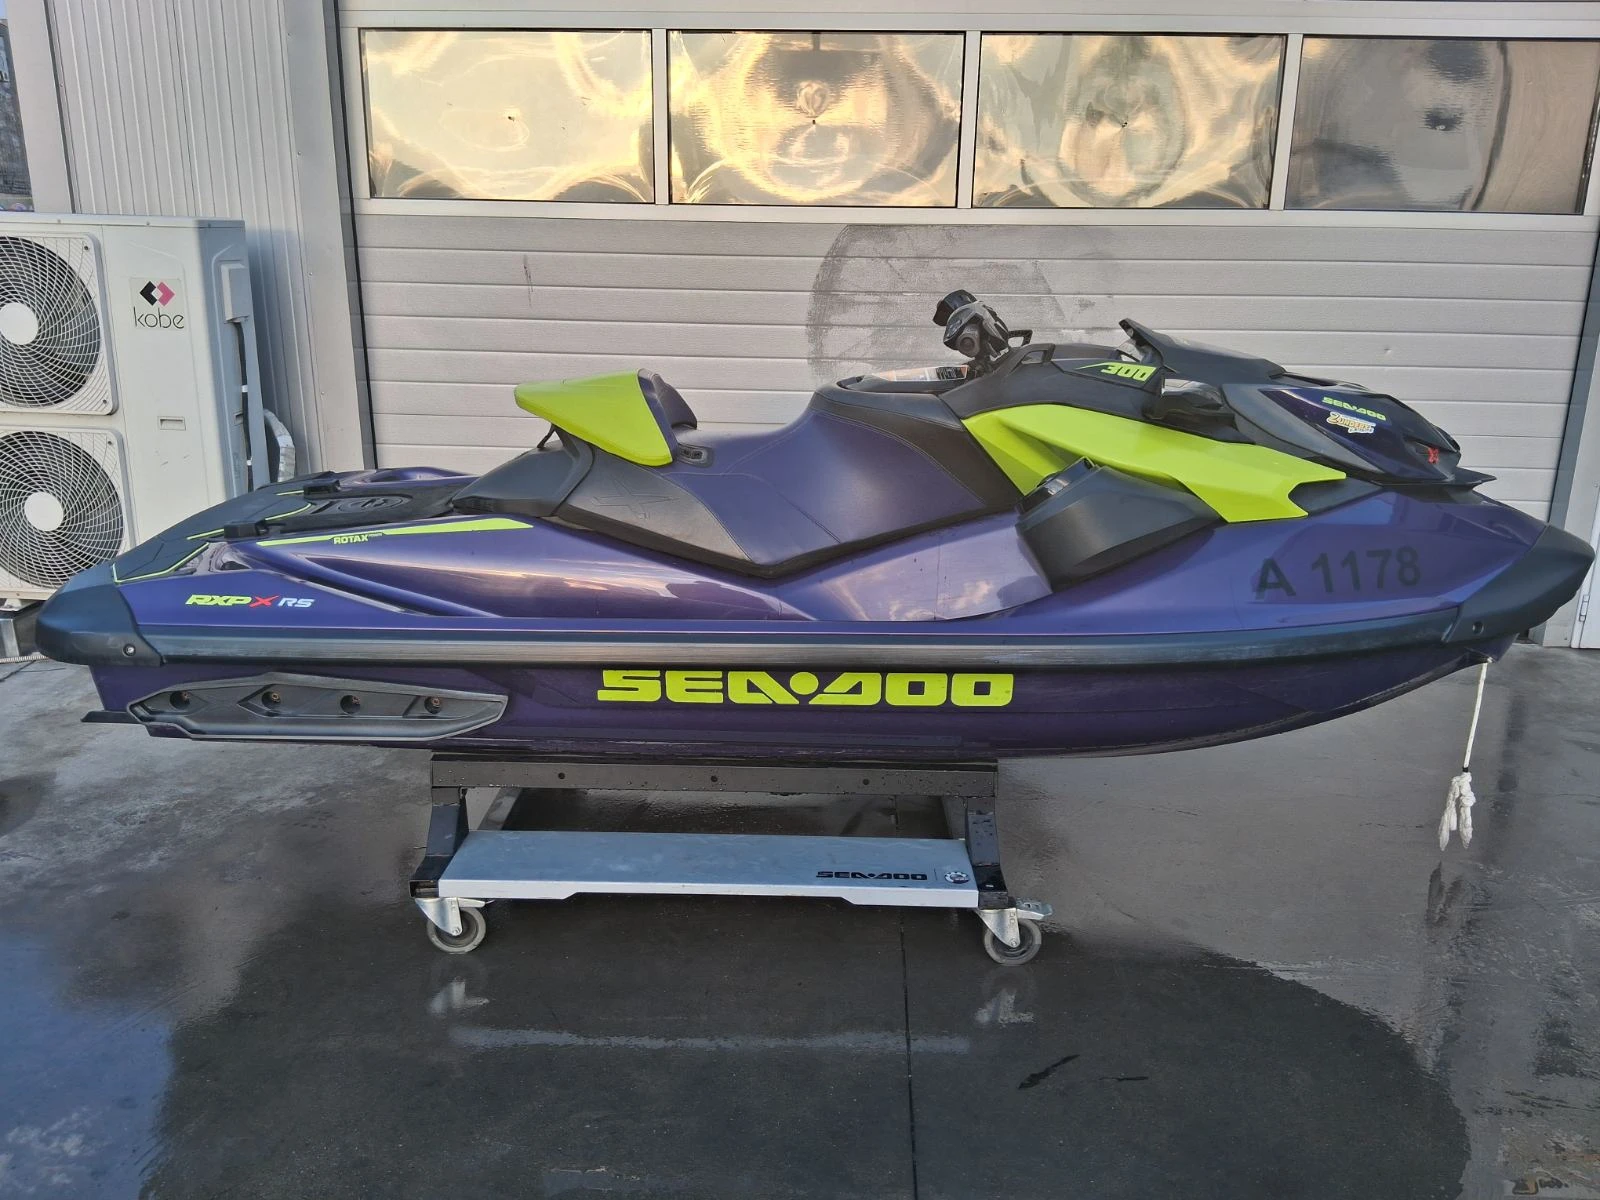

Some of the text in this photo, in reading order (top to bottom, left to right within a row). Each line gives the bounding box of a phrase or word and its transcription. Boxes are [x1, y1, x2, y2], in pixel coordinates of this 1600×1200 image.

[133, 306, 184, 329] kobe
[1100, 362, 1157, 382] 300
[333, 534, 369, 545] ROTAX
[1254, 546, 1421, 600] A 1178
[277, 597, 315, 608] RS
